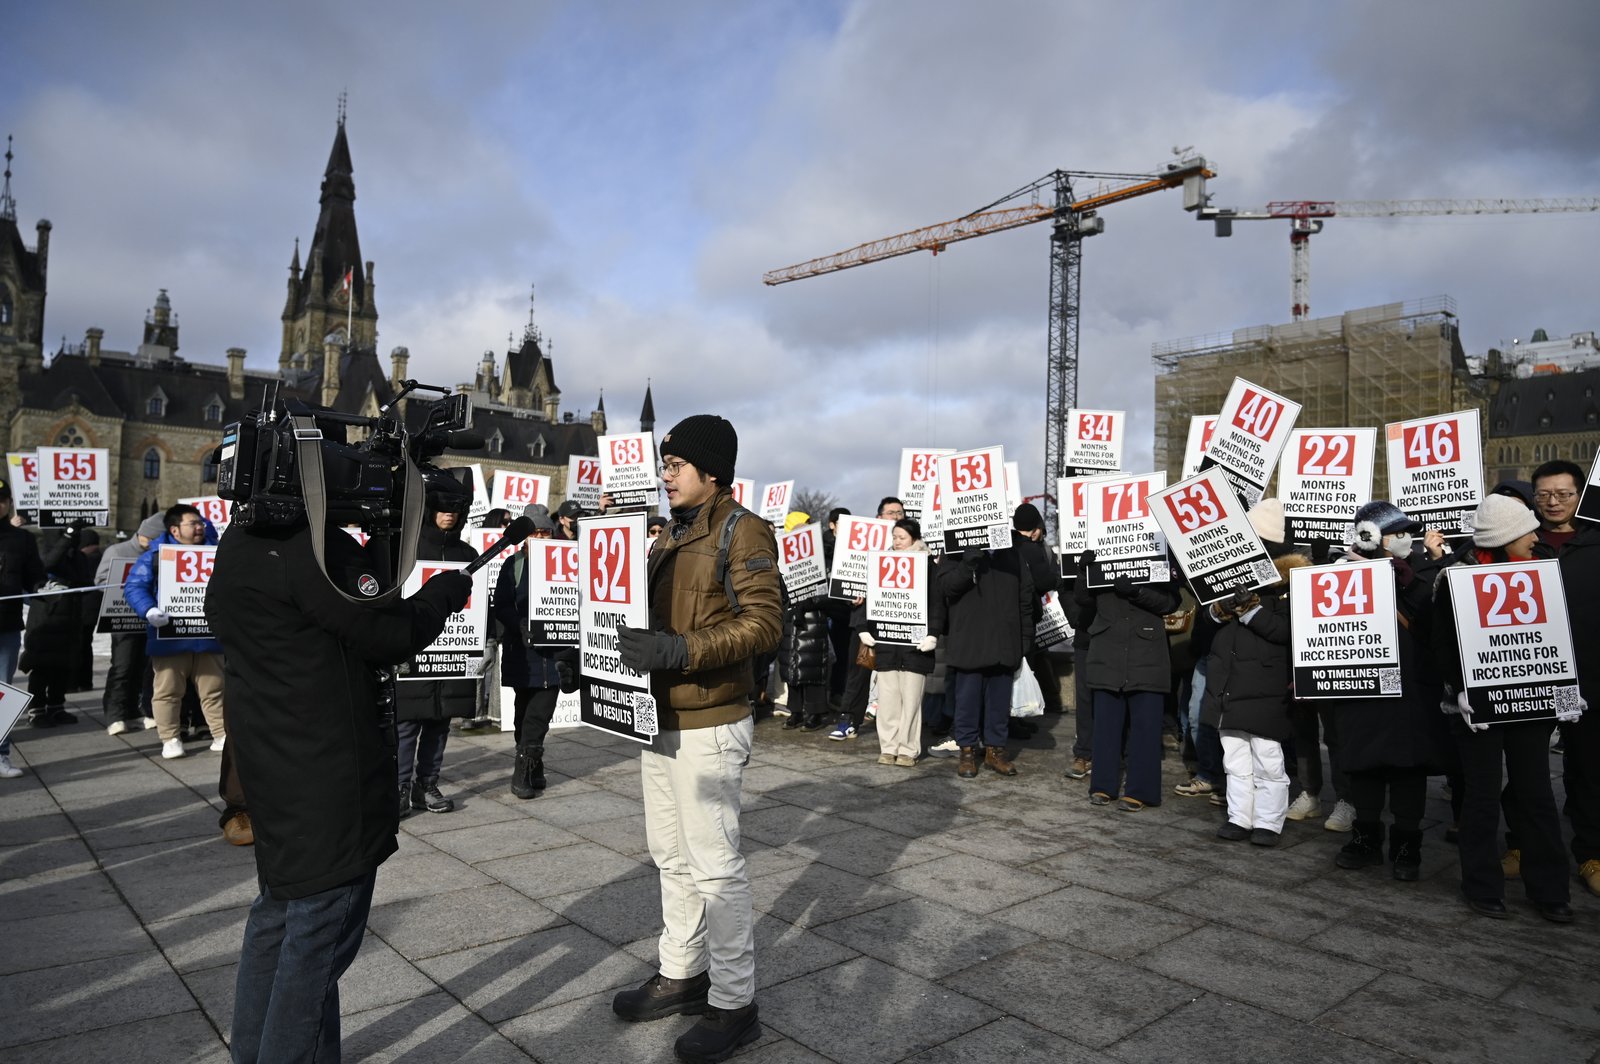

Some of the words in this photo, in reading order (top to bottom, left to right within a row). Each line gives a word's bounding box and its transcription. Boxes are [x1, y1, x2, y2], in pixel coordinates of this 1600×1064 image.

[1239, 394, 1278, 438] 40
[1081, 414, 1109, 441] 34
[1229, 431, 1262, 453] MONTHS
[1408, 422, 1454, 466] 46
[614, 439, 640, 465] 68
[1074, 450, 1100, 458] WAITING
[1219, 438, 1248, 459] WAITING
[1249, 455, 1265, 468] FOR
[1304, 435, 1349, 475] 22
[58, 453, 92, 480] 55
[913, 454, 938, 481] 38
[1084, 458, 1117, 466] RESPONSE
[1210, 446, 1226, 460] IRCC
[1225, 455, 1266, 481] RESPONSE
[580, 461, 600, 485] 27
[955, 455, 988, 491] 53
[1411, 467, 1456, 482] MONTHS
[508, 477, 534, 502] 19
[620, 480, 651, 488] RESPONSE
[1301, 480, 1346, 490] MONTHS
[1401, 482, 1445, 495] WAITING
[1447, 478, 1469, 490] FOR
[768, 486, 786, 507] 30
[956, 493, 989, 504] MONTHS
[1108, 482, 1143, 520] 71
[1290, 491, 1333, 502] WAITING
[1335, 493, 1357, 502] FOR
[1396, 497, 1419, 508] IRCC
[1420, 490, 1476, 505] RESPONSE
[950, 505, 981, 516] WAITING
[982, 502, 998, 511] FOR
[1170, 484, 1219, 530] 53
[1284, 503, 1305, 512] IRCC
[946, 517, 963, 526] IRCC
[964, 512, 1003, 524] RESPONSE
[1291, 520, 1304, 529] NO
[1305, 521, 1344, 530] TIMELINE
[1425, 520, 1462, 531] RESULTS
[954, 531, 964, 539] NO
[1106, 522, 1144, 534] MONTHS
[1189, 524, 1229, 546] MONTHS
[1294, 530, 1307, 538] NO
[1308, 531, 1344, 540] RESULTS
[851, 522, 883, 551] 30
[958, 539, 967, 547] NO
[1097, 535, 1134, 546] WAITING
[1136, 532, 1155, 541] FOR
[786, 531, 812, 562] 30
[1065, 541, 1084, 550] IRCC
[1095, 548, 1112, 557] RCC
[1112, 542, 1160, 555] RESPONSE
[1186, 537, 1225, 560] WAITING
[1225, 532, 1245, 547] FOR
[551, 546, 579, 582] 19
[1187, 559, 1208, 573] IRCC
[1208, 541, 1257, 566] RESPONSE
[180, 551, 215, 582] 35
[593, 528, 626, 602] 32
[788, 560, 813, 572] MONTHS
[881, 556, 911, 588] 28
[1101, 563, 1112, 571] NO
[1112, 559, 1151, 570] TIMELINES
[784, 569, 807, 581] WAITING
[808, 565, 819, 576] FOR
[794, 571, 823, 586] RESPONSE
[1104, 572, 1115, 580] NO
[1203, 574, 1216, 585] NO
[550, 586, 579, 595] MONTH
[841, 581, 850, 589] NO
[1211, 582, 1224, 594] NO
[1223, 573, 1256, 590] RESULTS
[881, 592, 910, 600] MONTHS
[1317, 569, 1367, 616] 34
[1482, 571, 1538, 626] 23
[165, 605, 184, 613] IRCC
[541, 597, 576, 606] WAITING
[875, 600, 902, 609] WAITING
[904, 602, 917, 610] FOR
[535, 607, 554, 616] IRCC
[871, 609, 885, 617] IRCC
[885, 611, 922, 620] RESPONSE
[593, 611, 627, 628] MONTHS
[876, 622, 884, 630] NO
[1318, 621, 1367, 633] MONTHS
[456, 625, 475, 634] FOR
[544, 623, 554, 631] NO
[555, 623, 579, 632] TIMELI
[878, 630, 887, 638] NO
[887, 631, 911, 640] RESULTS
[547, 632, 557, 640] NO
[587, 631, 618, 652] WAITING
[1307, 635, 1355, 648] WAITING
[1358, 633, 1382, 645] FOR
[1489, 631, 1543, 647] MONTHS
[415, 654, 427, 663] NO
[428, 654, 469, 662] TIMELINES
[583, 651, 599, 670] IRCC
[1300, 651, 1325, 661] IRCC
[1327, 647, 1390, 660] RESPONSE
[1477, 650, 1531, 664] WAITING
[1534, 646, 1559, 659] FOR
[418, 664, 430, 672] NO
[431, 663, 466, 672] RESULTS
[1312, 670, 1326, 679] NO
[1327, 668, 1379, 679] TIMELINES
[1472, 668, 1501, 681] IRCC
[1502, 661, 1568, 678] RESPONSE
[1317, 680, 1330, 690] NO
[1333, 680, 1375, 690] RESULTS
[590, 684, 599, 699] NO
[599, 685, 634, 707] TIMELINES
[1488, 690, 1503, 702] NO
[593, 702, 602, 717] NO
[603, 704, 632, 725] RESULTS
[1494, 703, 1509, 714] NO
[1511, 699, 1556, 713] RESULTS
